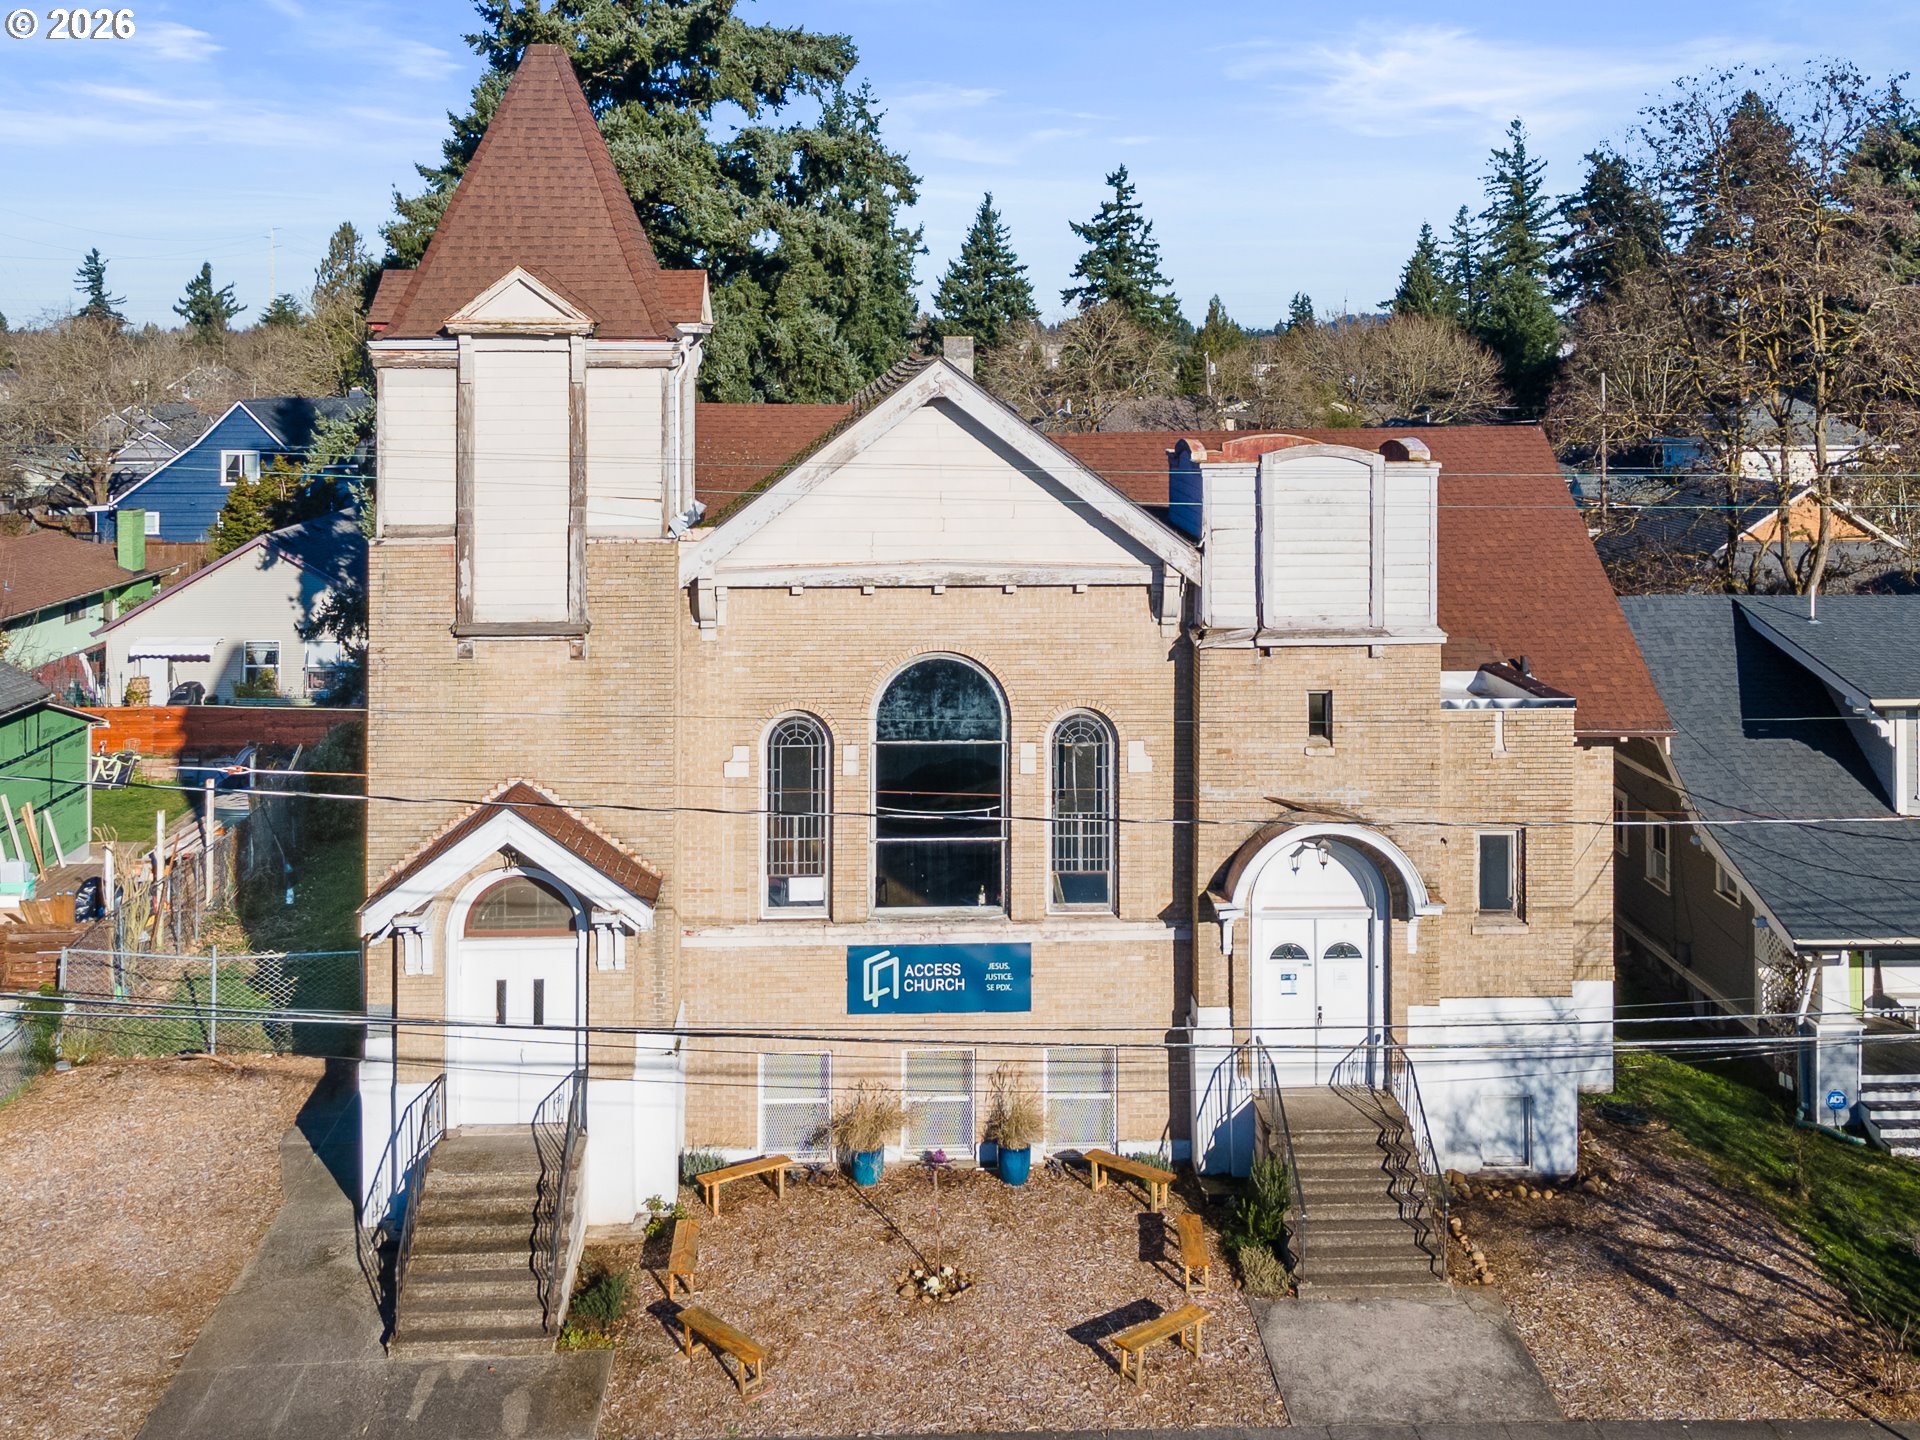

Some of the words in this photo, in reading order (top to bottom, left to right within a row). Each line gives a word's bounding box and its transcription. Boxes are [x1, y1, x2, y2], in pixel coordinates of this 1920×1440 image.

[904, 963, 961, 977] ACCESS
[988, 962, 1010, 970] JESUS.
[985, 973, 1014, 981] JUSTICE.
[904, 978, 965, 991] CHURCH
[996, 983, 1012, 991] PDX.
[1829, 1095, 1844, 1103] ADT
